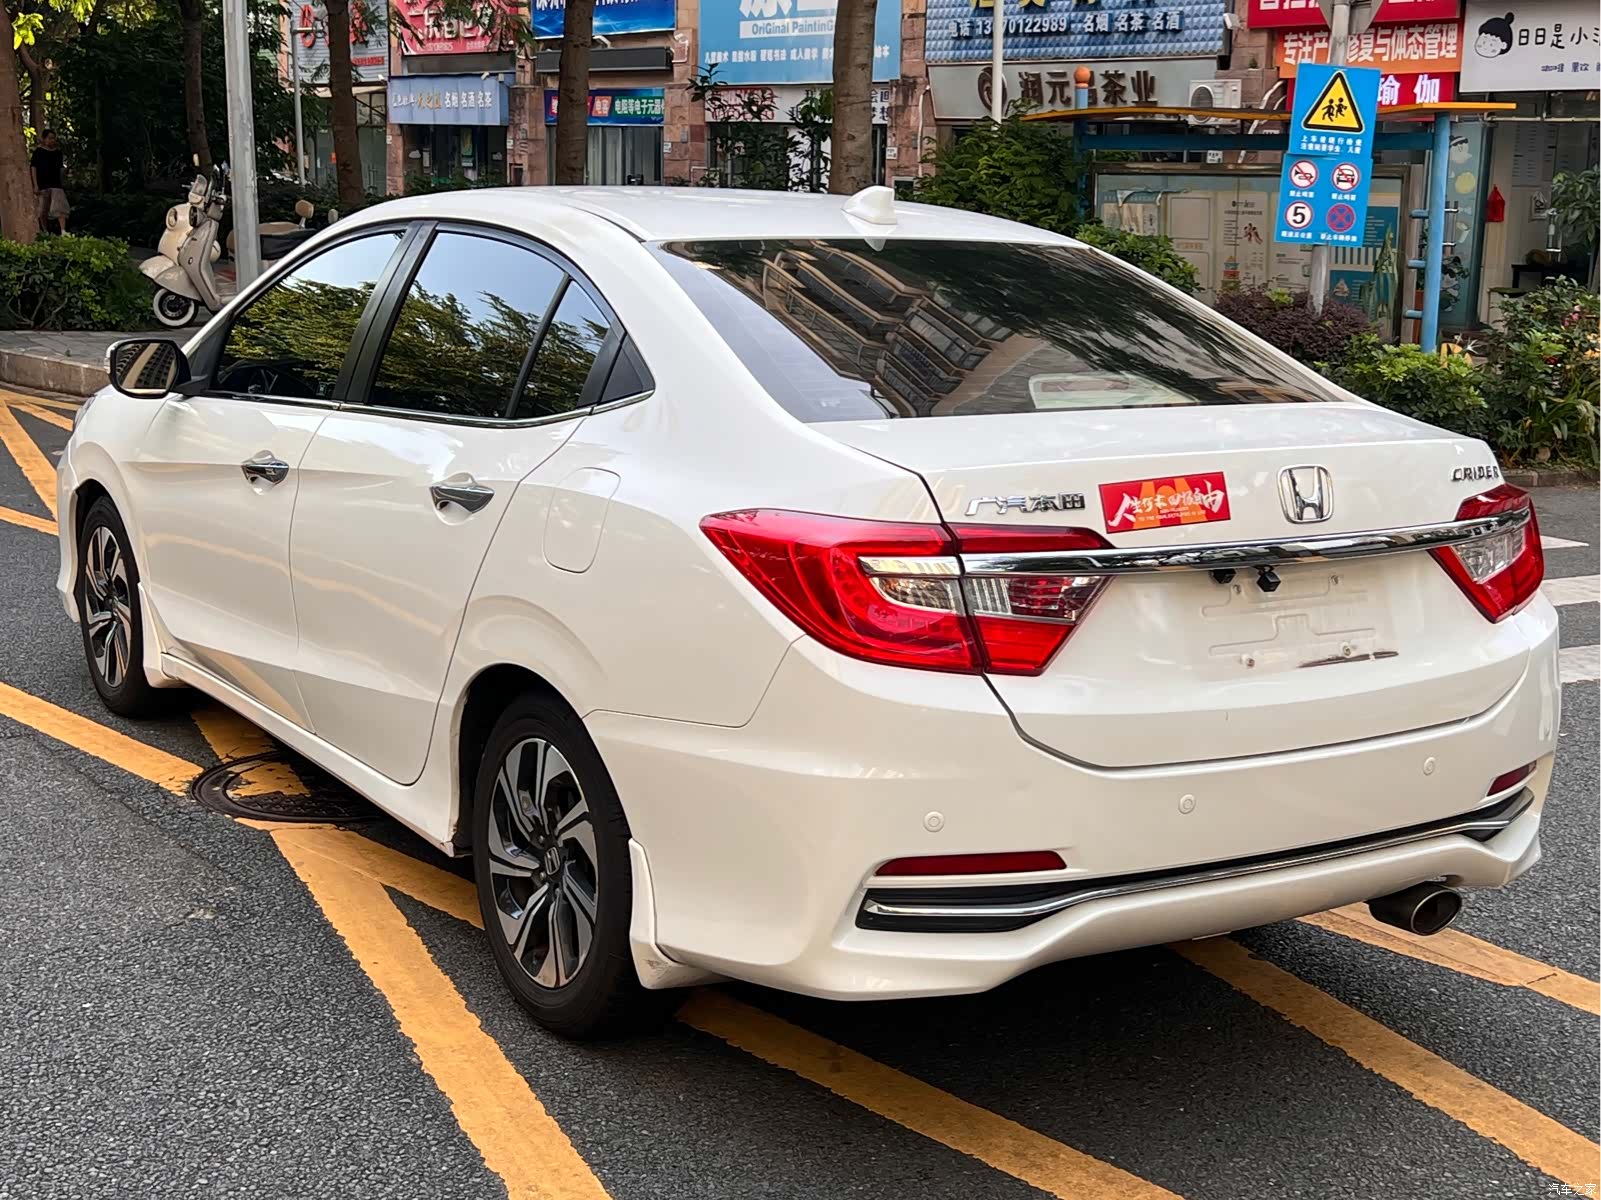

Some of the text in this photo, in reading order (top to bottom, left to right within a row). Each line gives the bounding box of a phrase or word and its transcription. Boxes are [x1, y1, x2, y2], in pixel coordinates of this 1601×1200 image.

[751, 20, 834, 35] OriGinal PaintinG
[948, 21, 970, 37] 电话
[976, 17, 1067, 35] 1370122989
[1115, 11, 1144, 32] 名茶
[1152, 10, 1180, 31] 名酒
[1283, 23, 1458, 65] 专注产修复与体态管理
[1376, 73, 1440, 105] 瑜伽
[1292, 206, 1306, 225] 5
[1451, 465, 1500, 481] CRIDER
[964, 493, 1085, 516] 广汽本田
